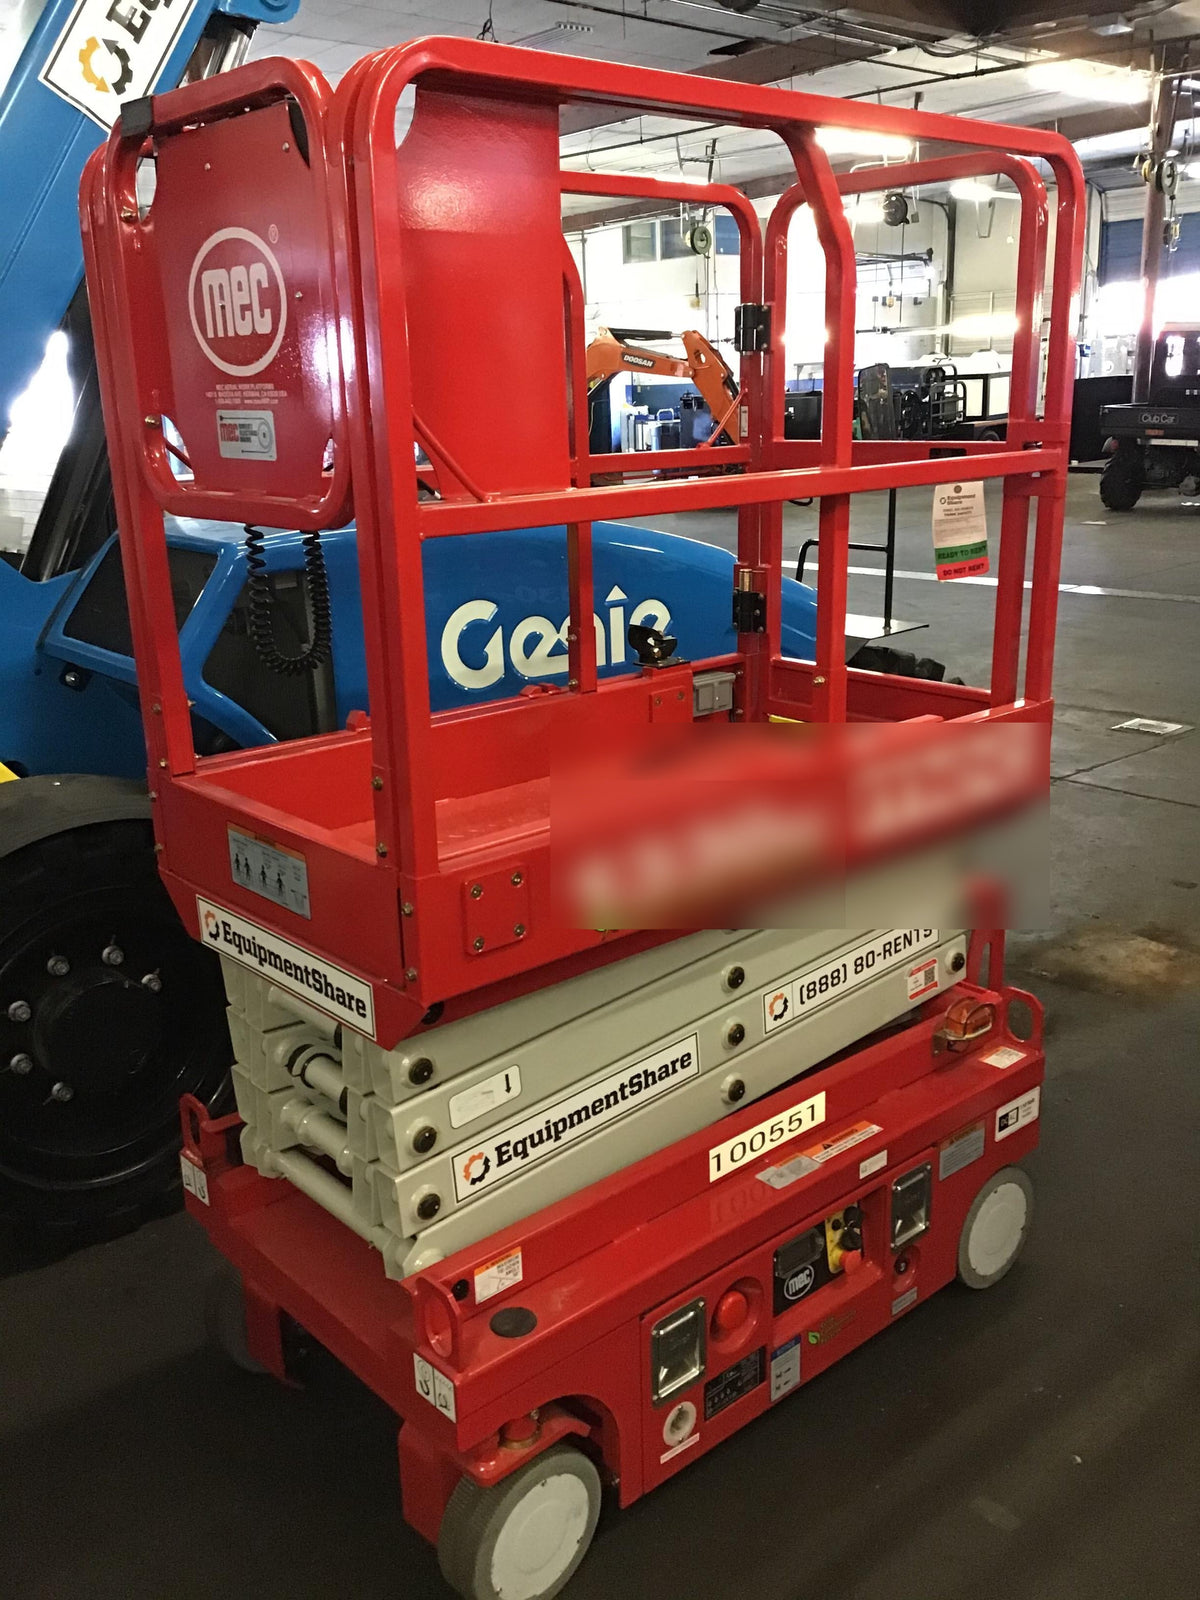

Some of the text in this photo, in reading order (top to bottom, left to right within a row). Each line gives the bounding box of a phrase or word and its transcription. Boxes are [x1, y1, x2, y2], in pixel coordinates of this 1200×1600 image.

[623, 354, 654, 368] DOOSAN
[1141, 413, 1175, 423] Club Car
[938, 545, 987, 560] READY TO RENT
[953, 566, 967, 574] NOT
[968, 563, 984, 572] RENT
[221, 920, 367, 1018] EquipmentShare
[799, 963, 847, 1005] (888)
[494, 1052, 692, 1168] EquipmentShare
[711, 1104, 816, 1172] 100551
